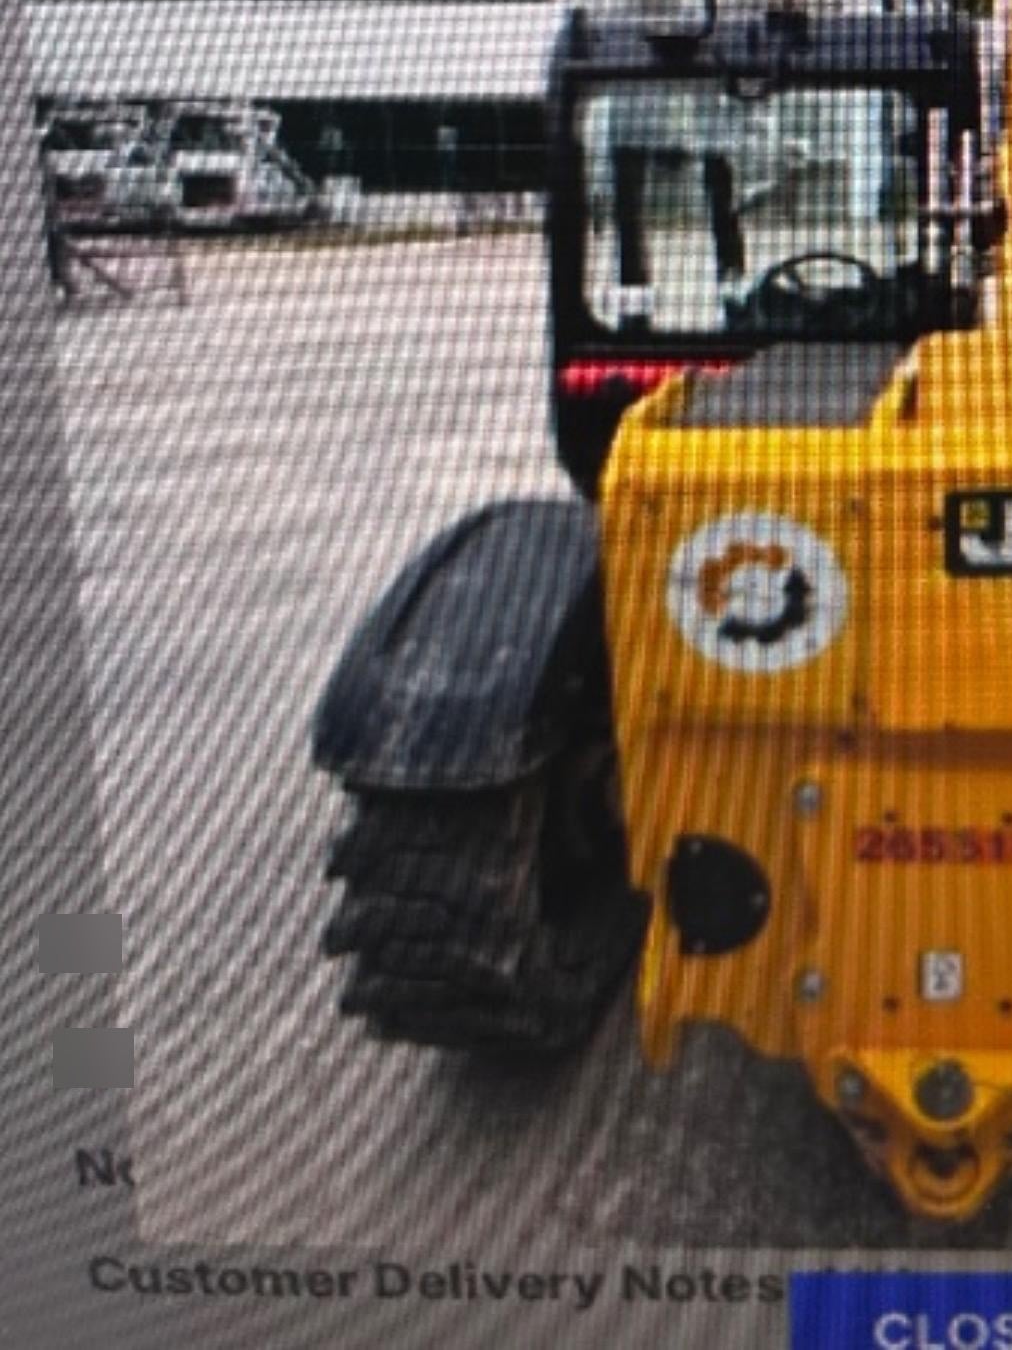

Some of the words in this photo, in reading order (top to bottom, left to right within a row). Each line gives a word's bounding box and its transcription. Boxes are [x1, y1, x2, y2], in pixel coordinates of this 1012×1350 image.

[87, 1255, 359, 1298] Customer
[374, 1261, 606, 1312] Delivery
[622, 1264, 785, 1303] Notes
